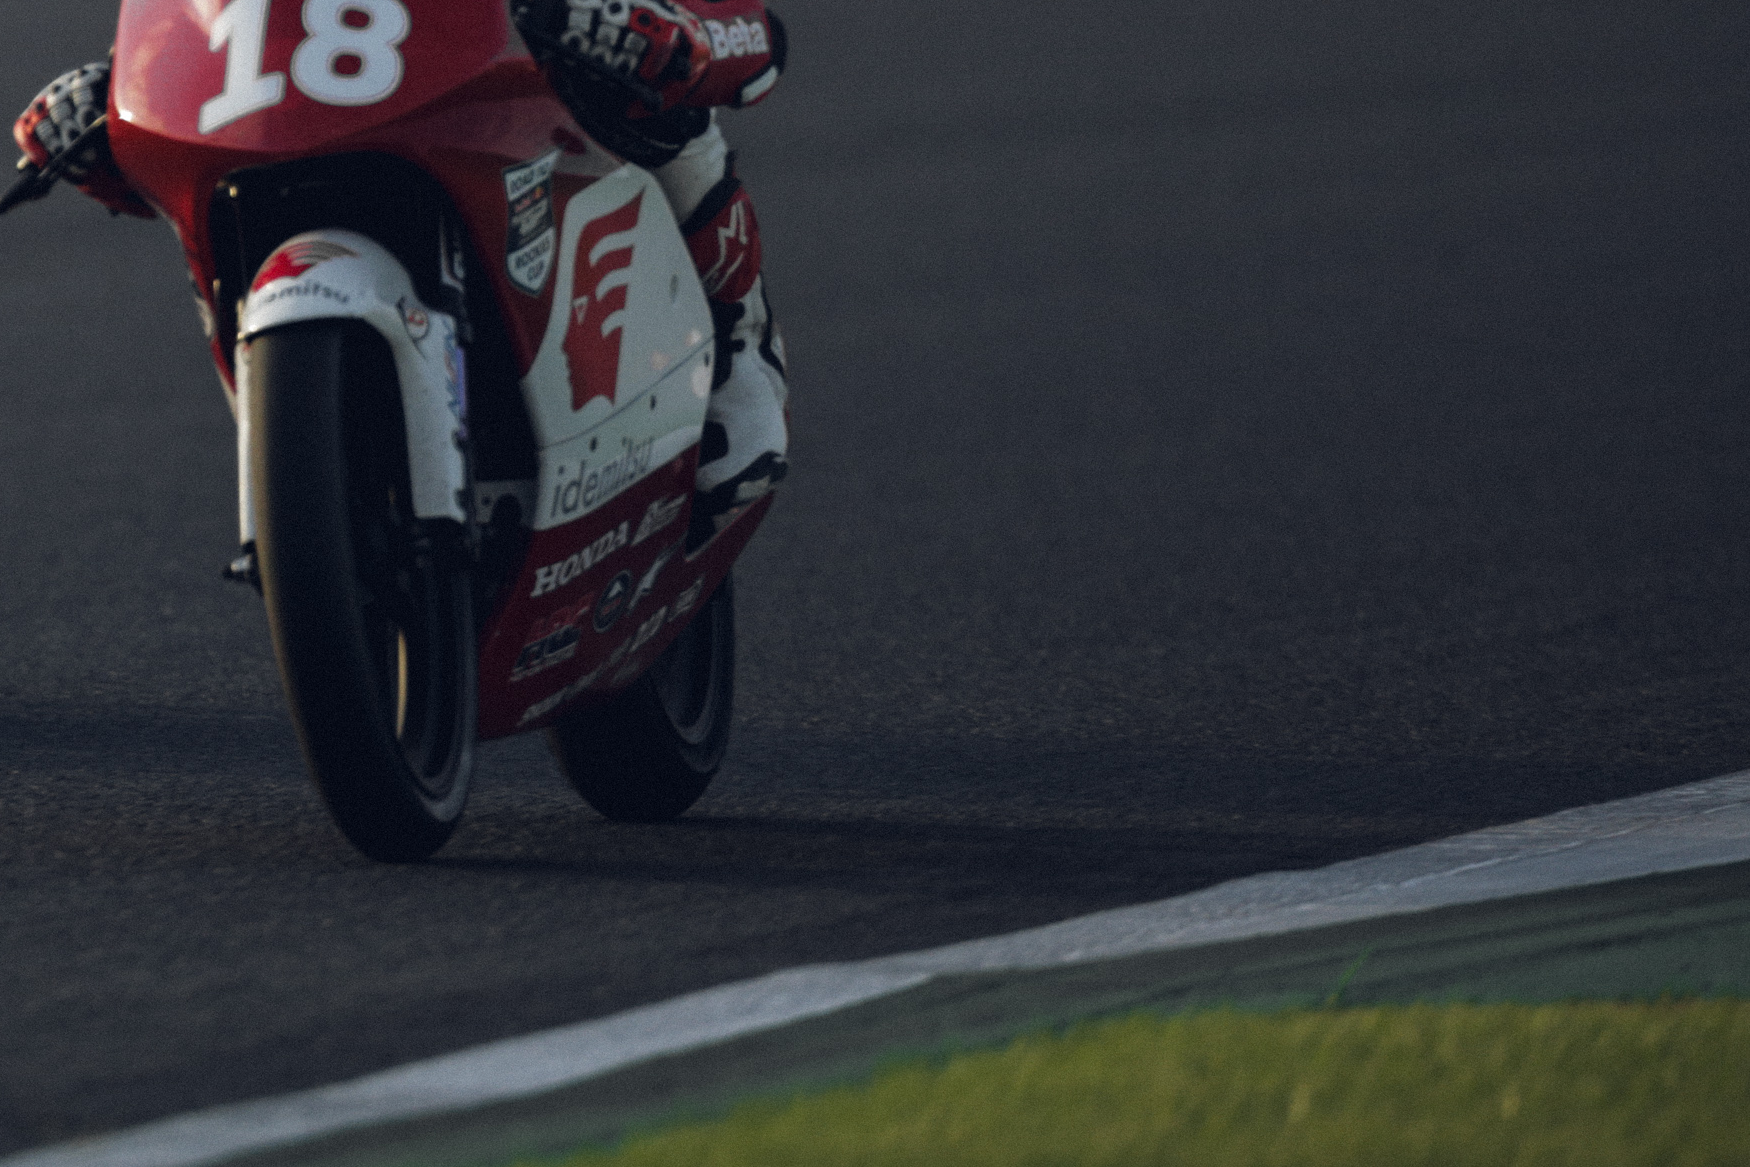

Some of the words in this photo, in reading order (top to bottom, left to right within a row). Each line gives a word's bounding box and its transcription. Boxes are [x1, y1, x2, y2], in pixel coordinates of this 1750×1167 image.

[705, 15, 770, 62] Beta
[550, 436, 655, 519] idemitsu
[529, 519, 631, 600] HONDA
